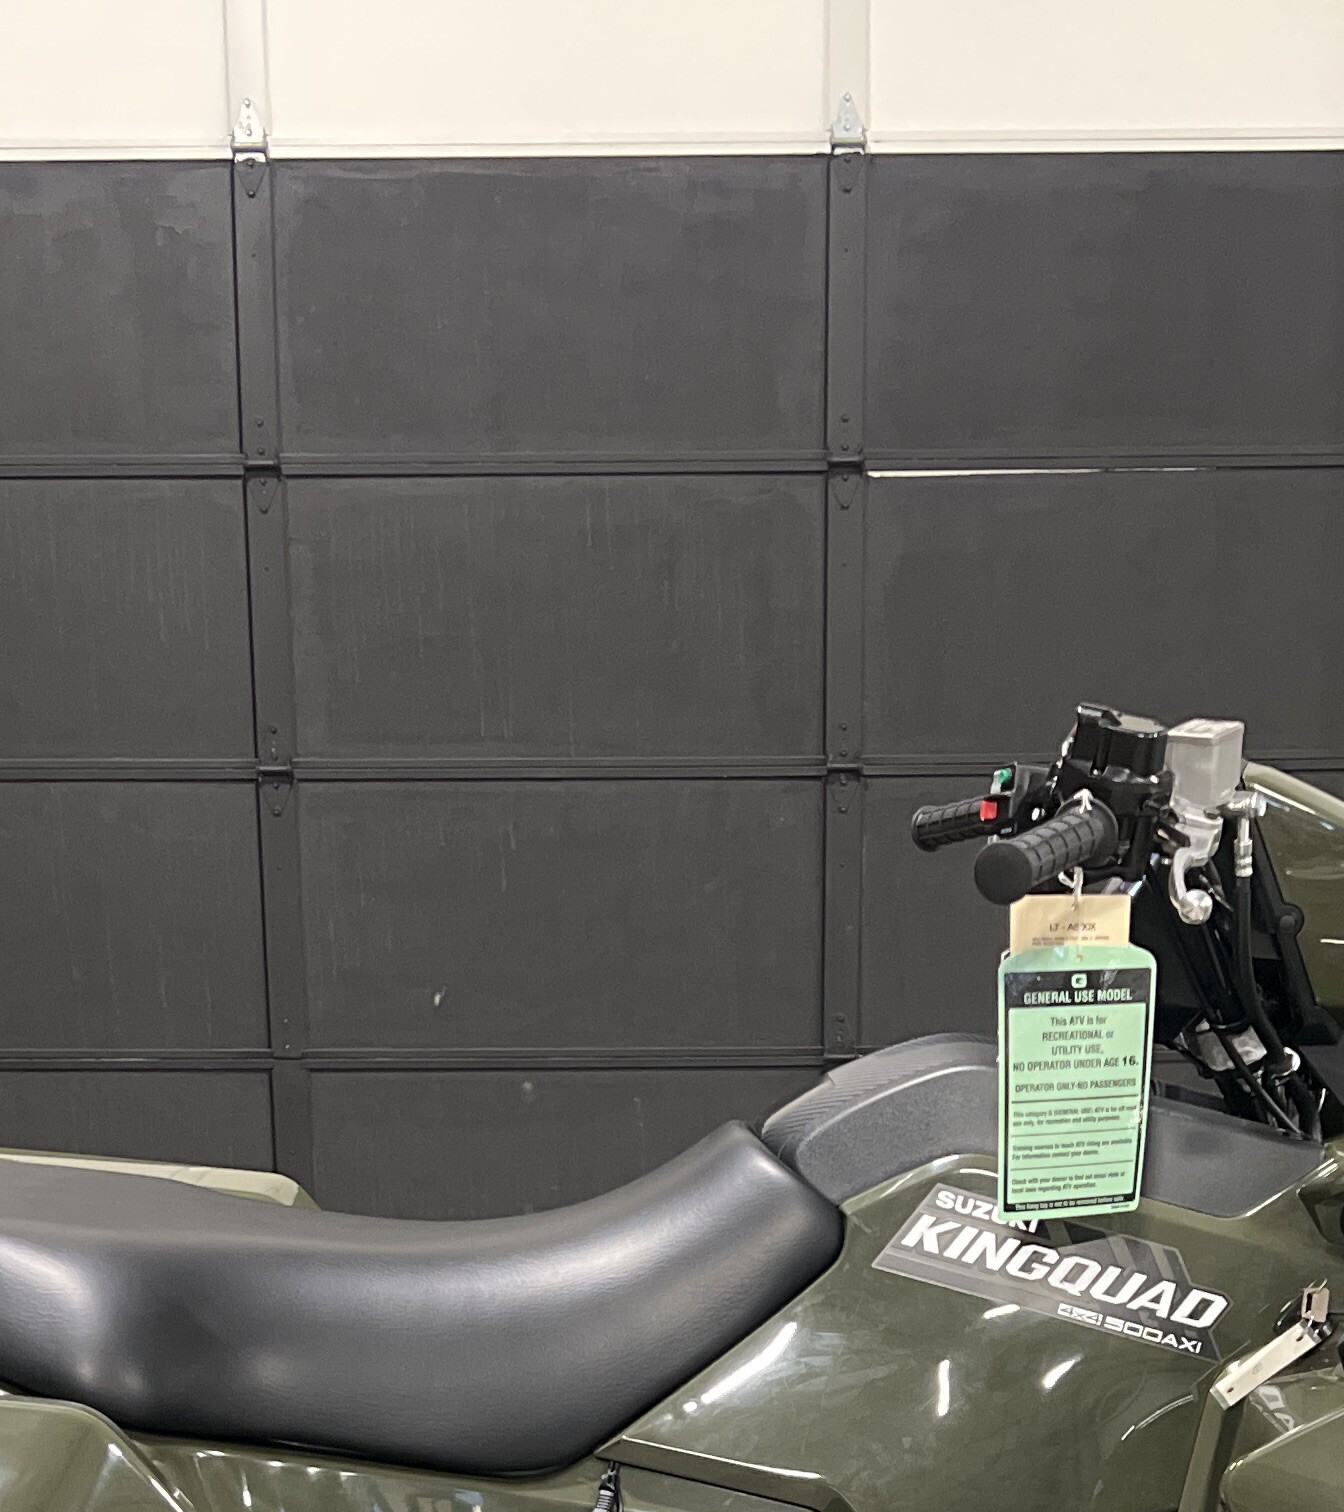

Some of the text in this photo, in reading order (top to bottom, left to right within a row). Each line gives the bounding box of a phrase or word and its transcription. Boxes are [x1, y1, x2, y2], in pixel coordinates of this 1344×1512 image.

[1023, 988, 1133, 1005] GENERAL USE MODEL
[1051, 1014, 1107, 1026] This ATV is for
[1042, 1030, 1114, 1042] RECREATIONAL or
[1051, 1045, 1082, 1056] UTILITY
[1012, 1062, 1025, 1072] NO
[1027, 1059, 1072, 1071] OPERATOR
[1074, 1058, 1102, 1068] UNDER
[1104, 1057, 1120, 1067] AGE
[1015, 1082, 1054, 1092] OPERATOR
[1090, 1078, 1137, 1089] PASSENGERS
[901, 1213, 1229, 1329] KINGQUAD
